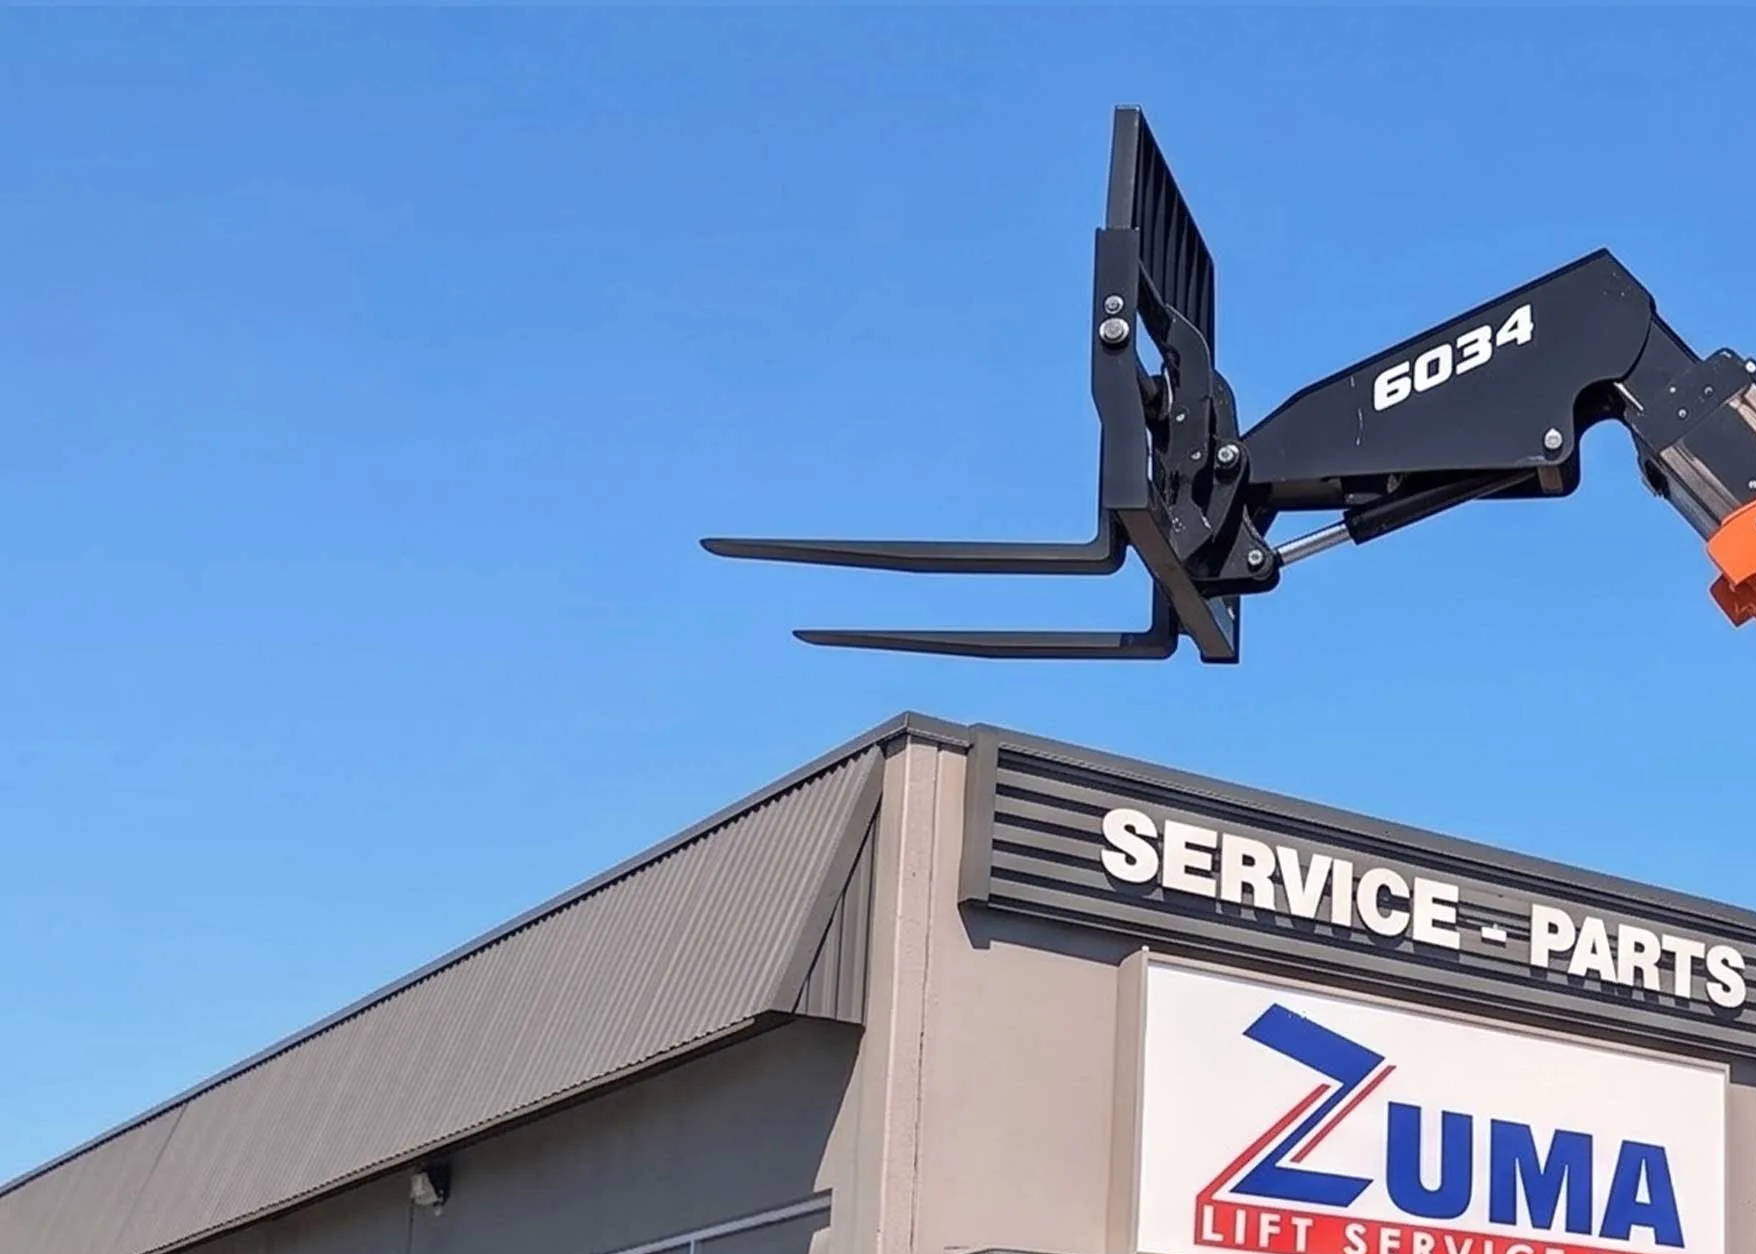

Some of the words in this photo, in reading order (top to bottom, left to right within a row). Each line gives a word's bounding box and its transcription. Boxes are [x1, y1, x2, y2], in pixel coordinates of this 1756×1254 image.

[1373, 304, 1534, 412] 6034
[1100, 808, 1461, 950] SERVICE
[1529, 903, 1748, 1009] PARTS
[1229, 1003, 1686, 1249] ZUMA
[1201, 1204, 1314, 1253] LIFT
